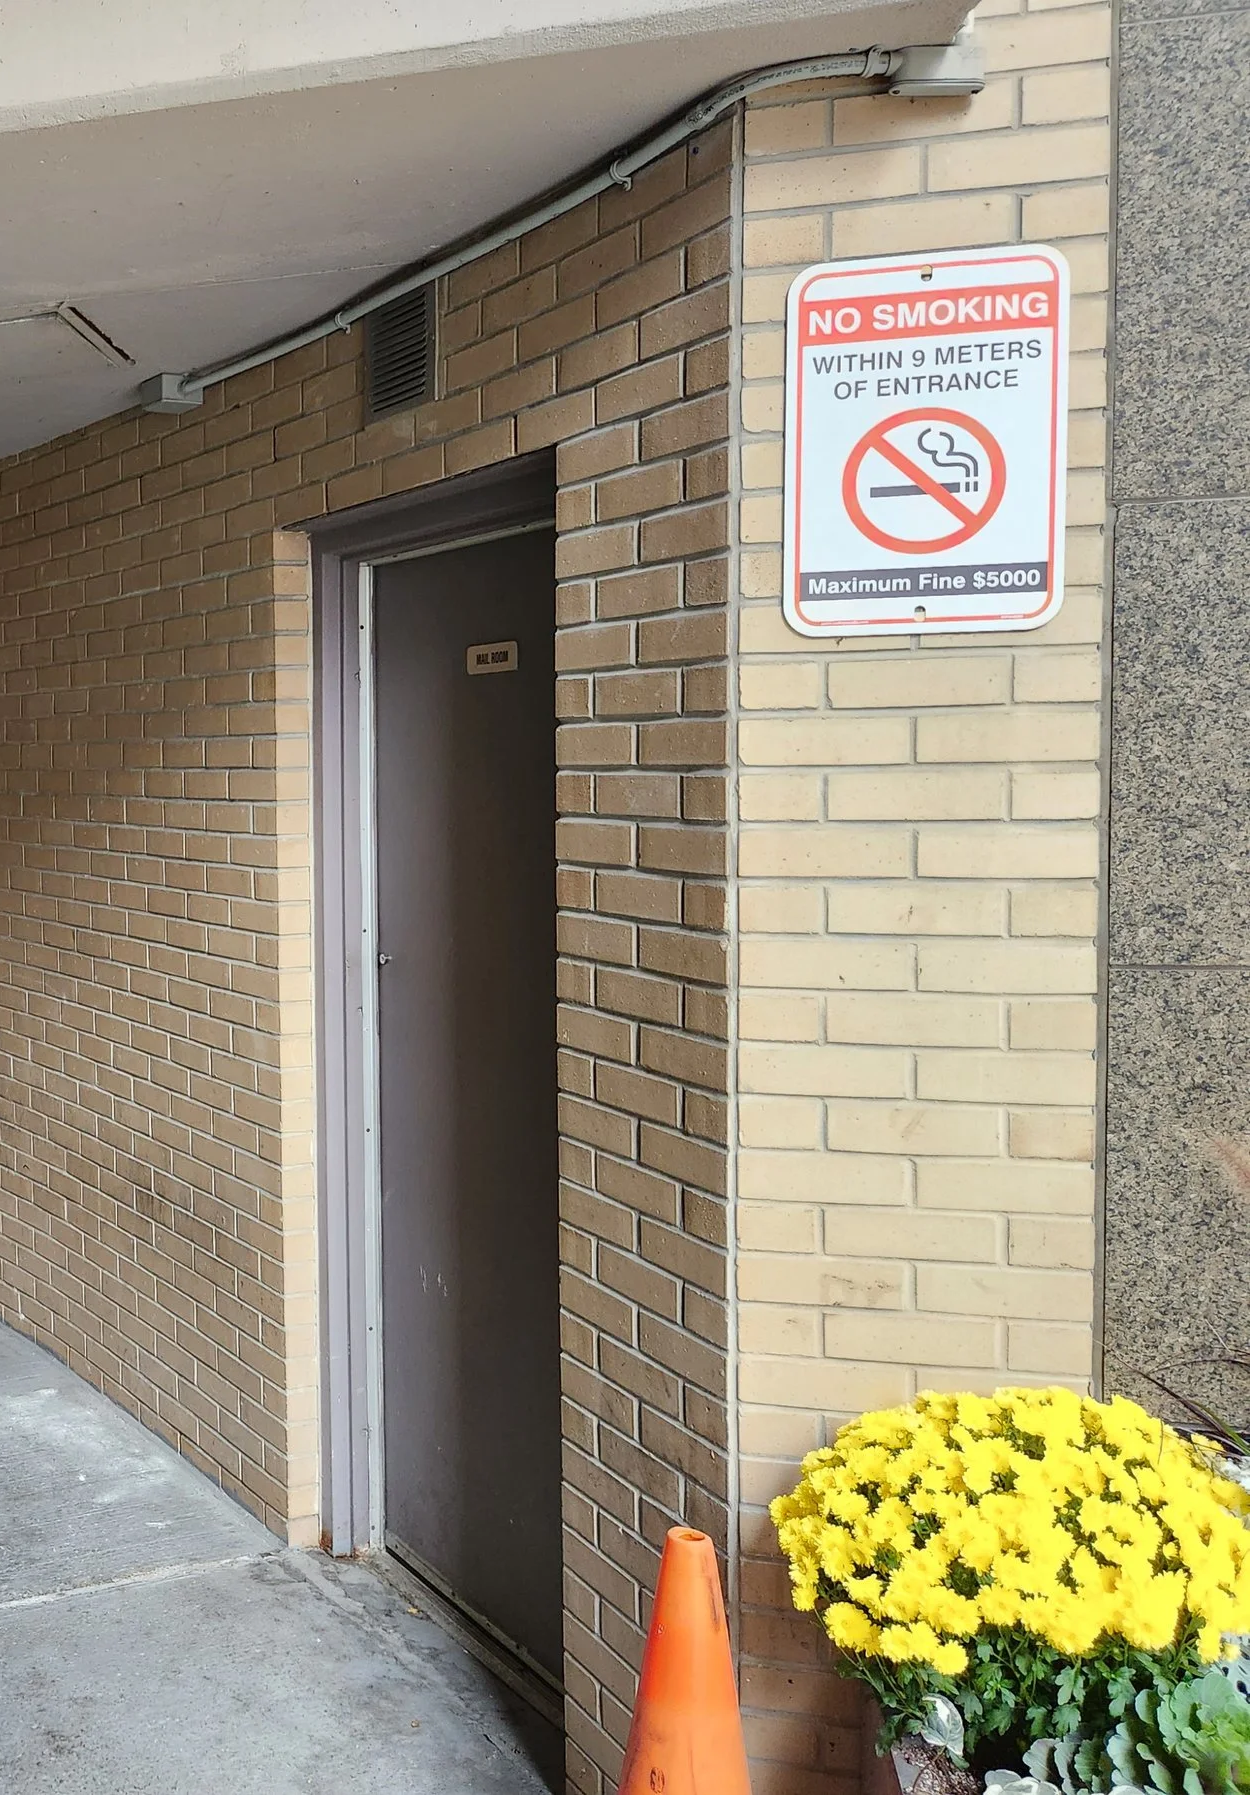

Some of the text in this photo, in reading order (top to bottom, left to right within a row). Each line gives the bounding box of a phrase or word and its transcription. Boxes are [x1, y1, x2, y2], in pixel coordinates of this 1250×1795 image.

[809, 292, 1049, 336] NO SMOKING
[813, 339, 1042, 375] WITHIN 9 METERS
[834, 369, 1019, 400] OF ENTRANCE
[808, 569, 1041, 596] Maximum Fine $5000
